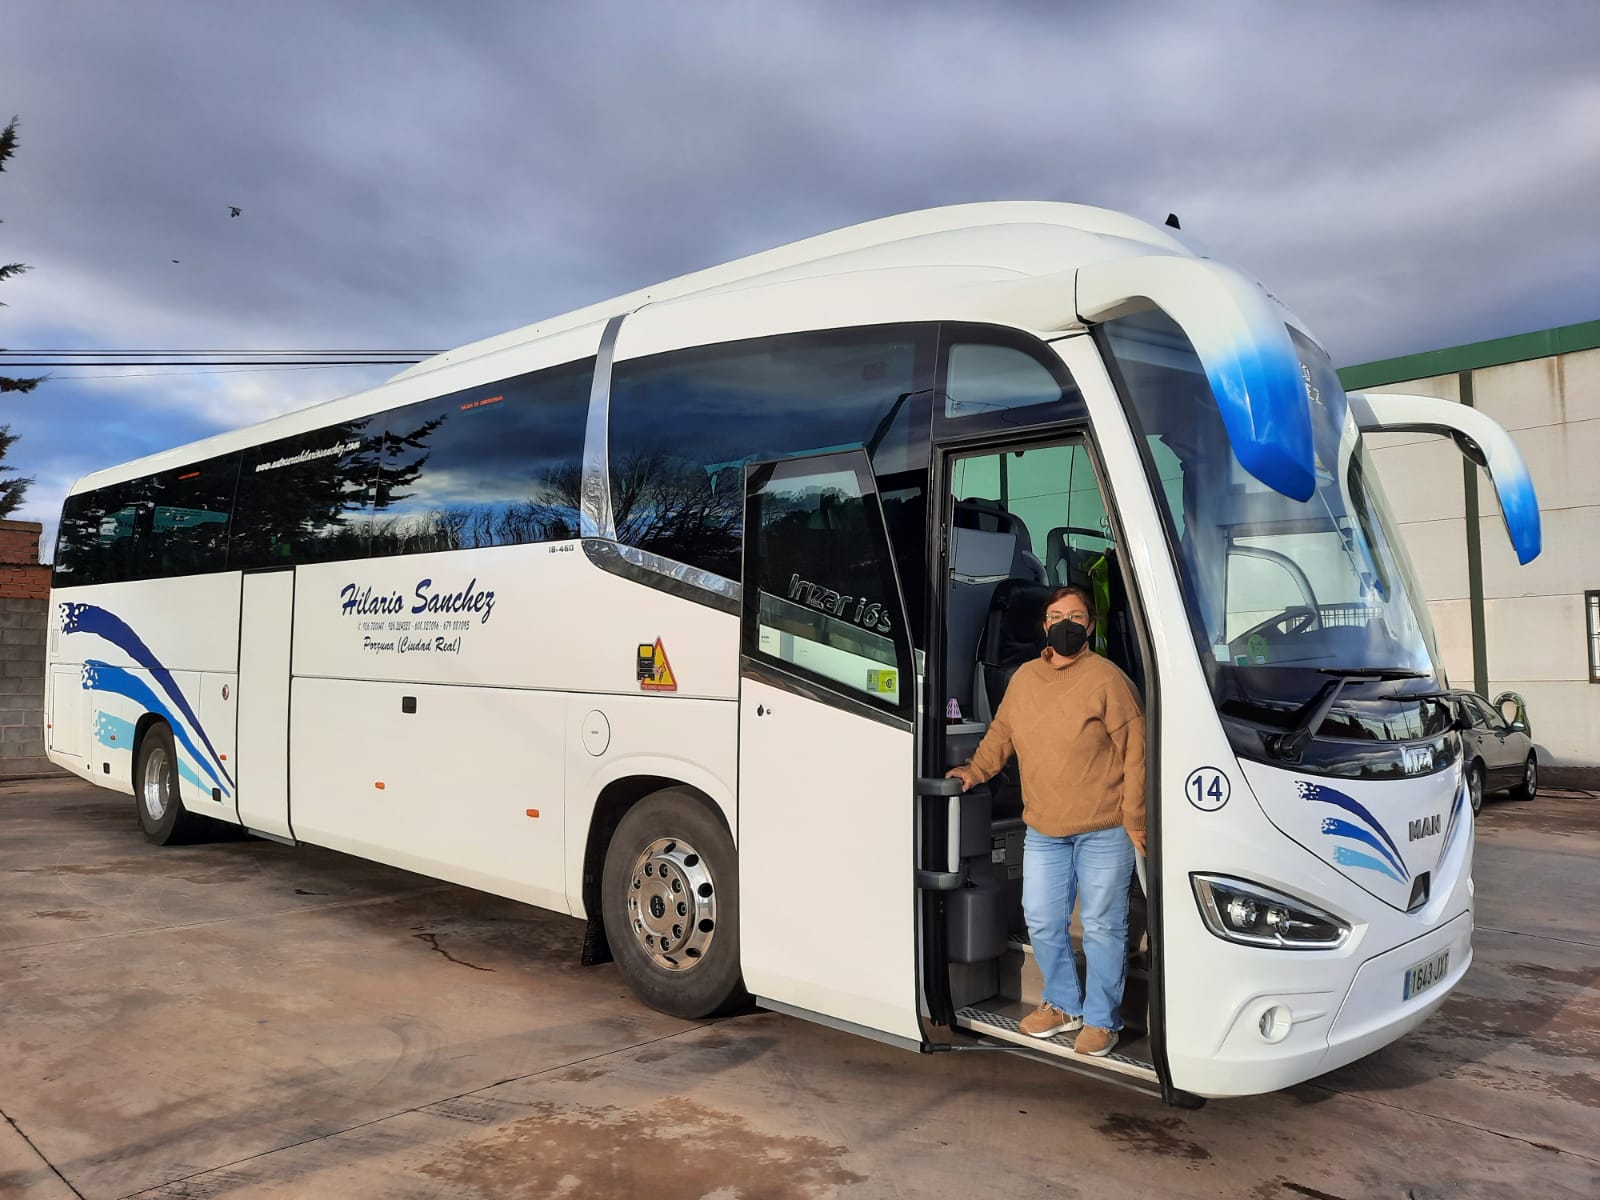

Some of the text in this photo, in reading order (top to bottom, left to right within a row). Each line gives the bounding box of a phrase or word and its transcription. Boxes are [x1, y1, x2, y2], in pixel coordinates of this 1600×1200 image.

[340, 577, 495, 625] Hilario Sanchez
[787, 573, 892, 634] Irizar i6s
[363, 636, 462, 655] Porzuna (Ciudad Real)
[1192, 775, 1223, 802] 14
[1408, 814, 1442, 842] MAN
[1412, 961, 1434, 993] 1643
